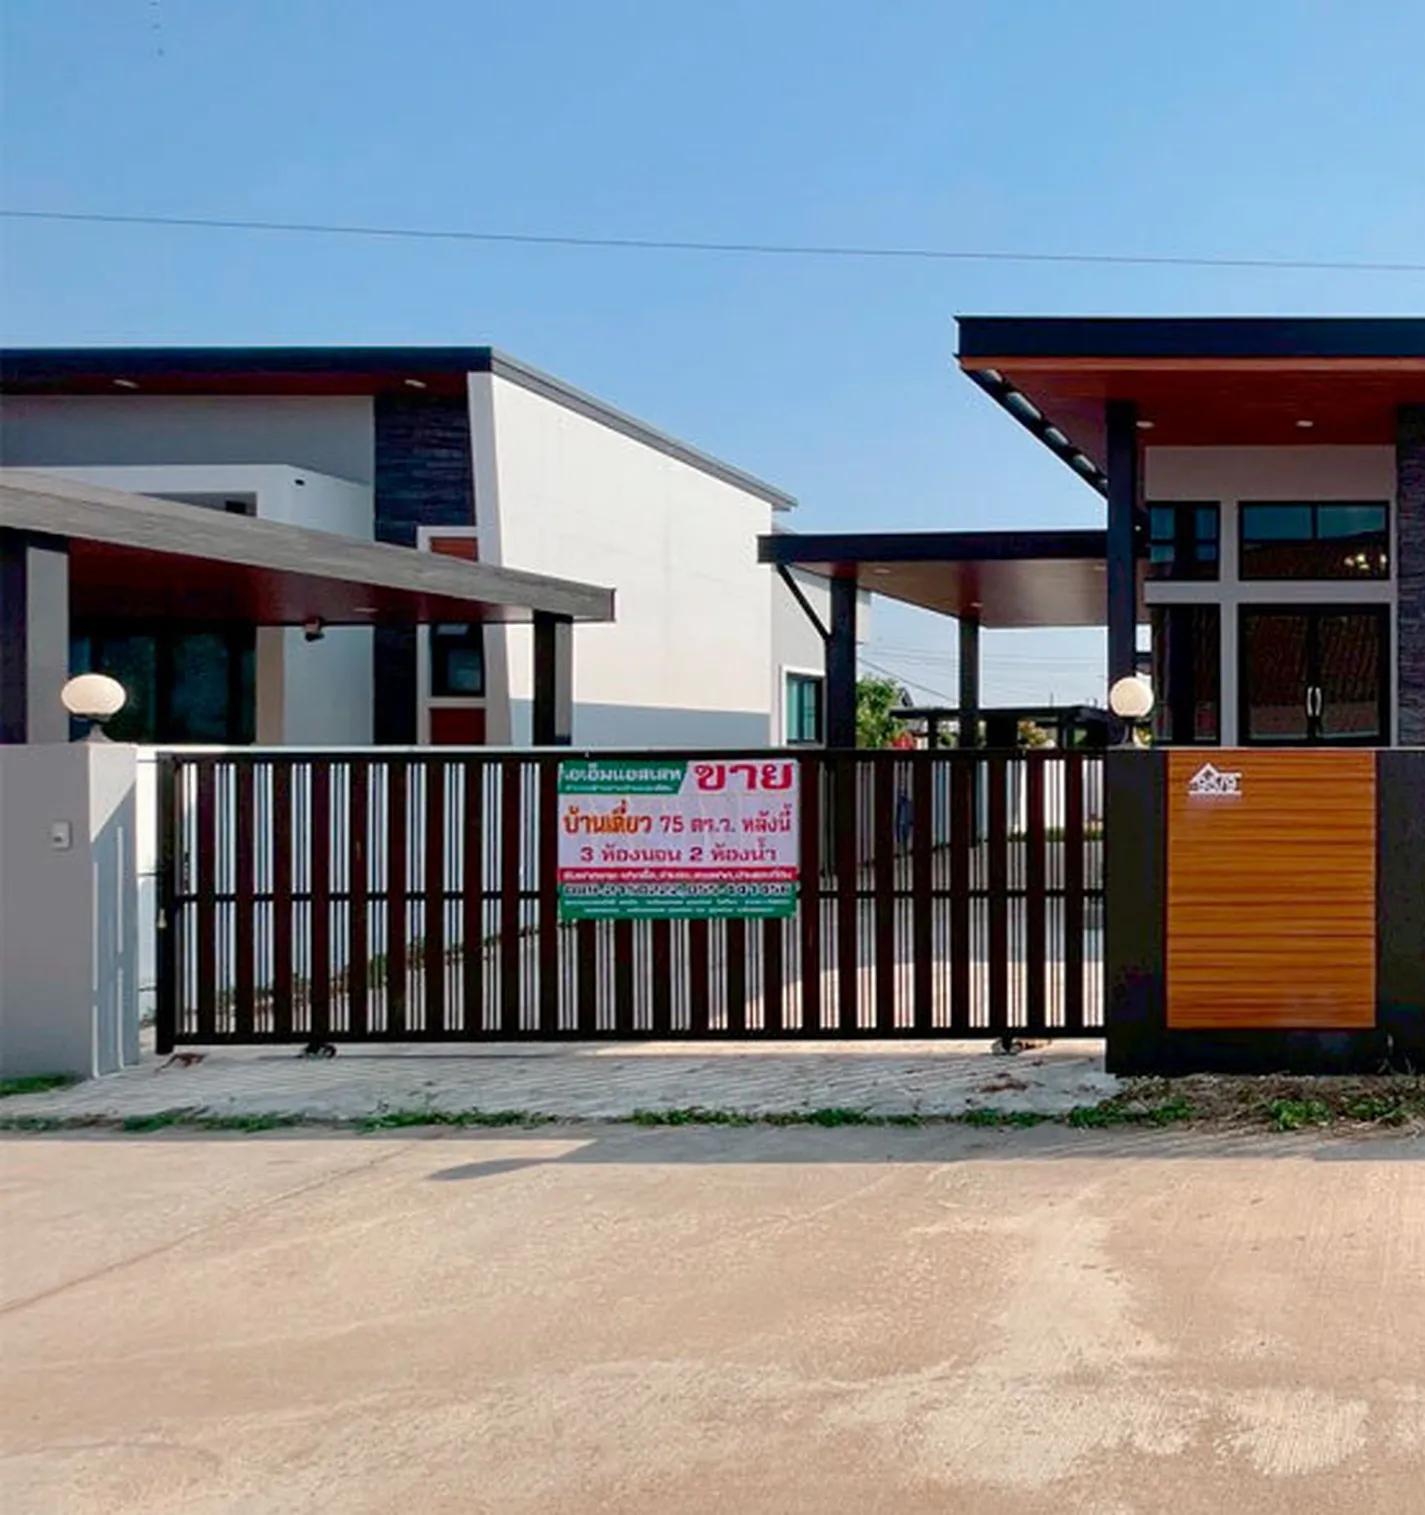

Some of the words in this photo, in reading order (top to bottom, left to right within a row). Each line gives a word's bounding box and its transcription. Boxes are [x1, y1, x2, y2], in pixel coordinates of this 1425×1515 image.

[695, 763, 793, 791] ขาย
[564, 799, 652, 834] บ้านเดี่ยว
[660, 815, 684, 833] 75
[581, 846, 594, 862] 3
[601, 843, 681, 862] ห้องนอน
[690, 846, 703, 862] 2
[711, 837, 777, 861] ห้องน้ำ
